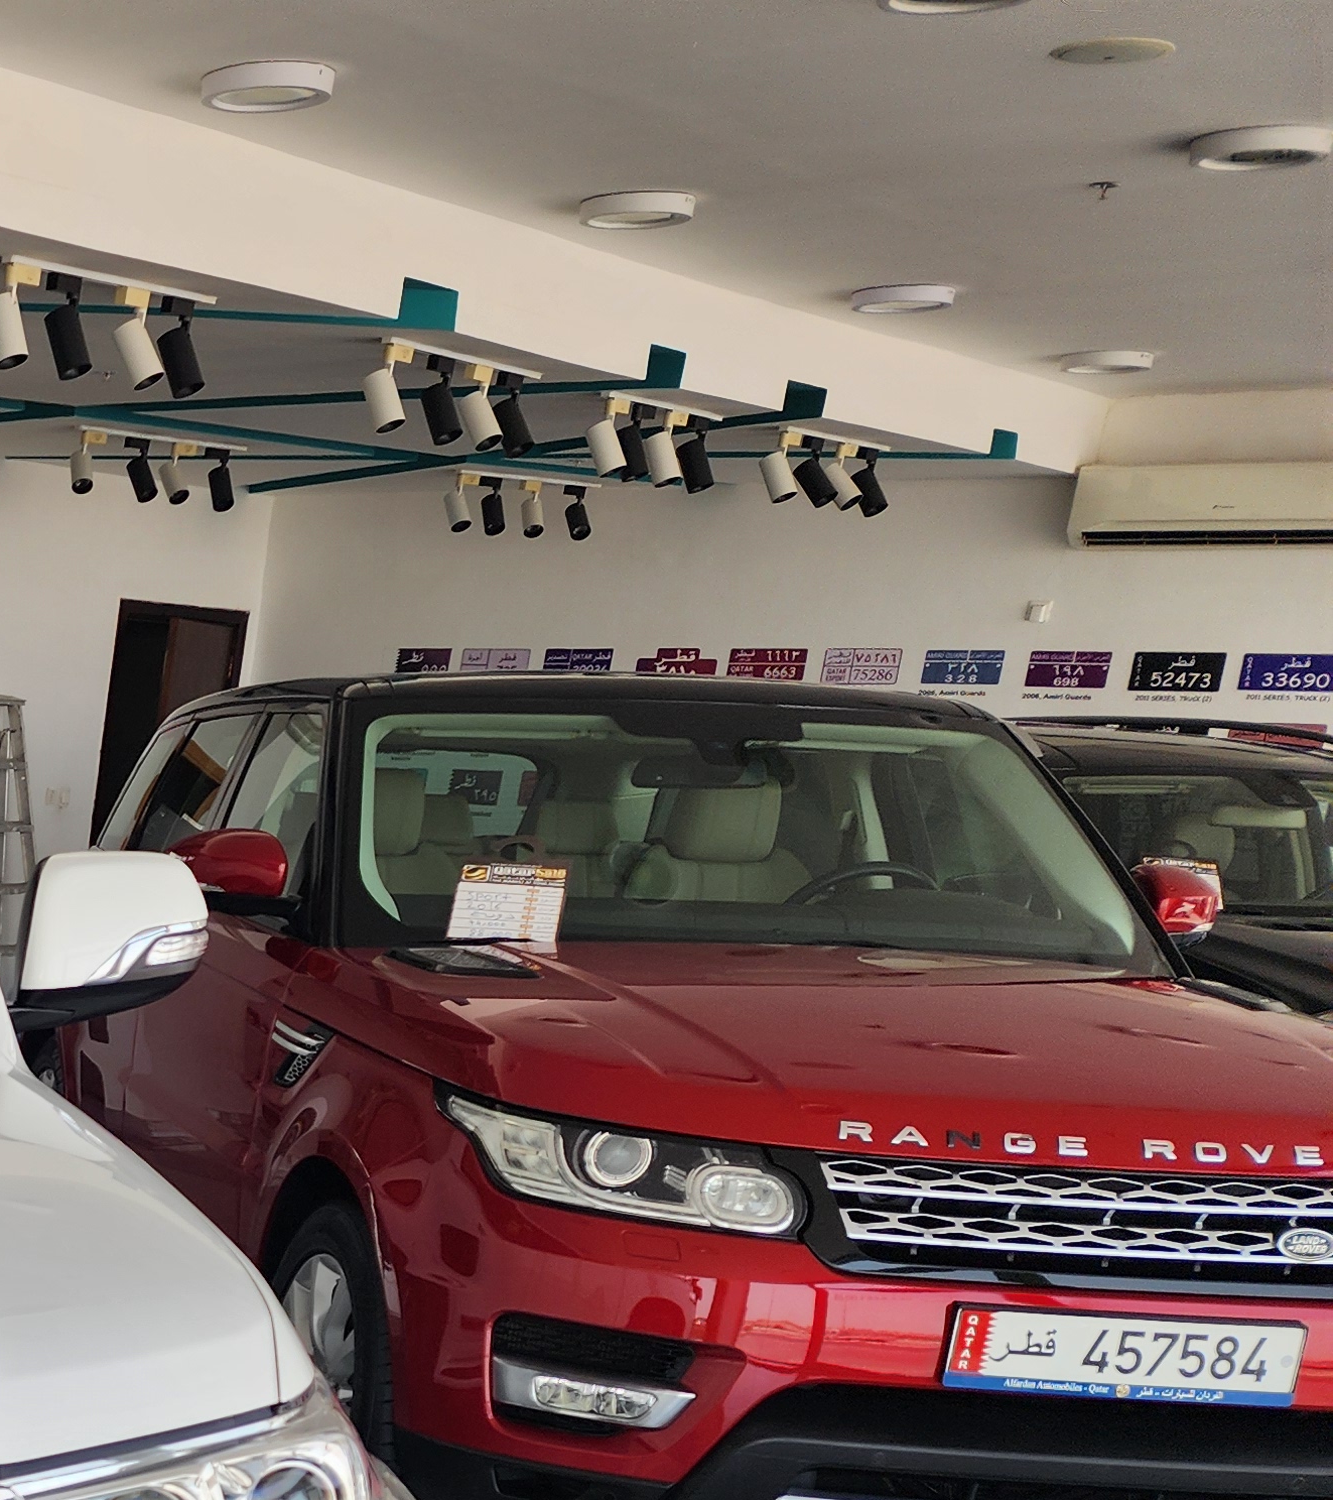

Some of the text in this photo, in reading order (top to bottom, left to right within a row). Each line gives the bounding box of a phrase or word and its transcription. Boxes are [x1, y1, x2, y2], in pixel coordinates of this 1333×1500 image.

[654, 649, 696, 665] قطر
[1168, 655, 1196, 670] قطر
[1280, 656, 1312, 671] قطر
[730, 665, 754, 673] QATAR
[764, 665, 797, 679] 6663
[853, 668, 893, 681] 75286
[944, 674, 978, 683] 328
[1053, 676, 1079, 687] 698
[1149, 671, 1212, 688] 52473
[1261, 671, 1331, 689] 33690
[838, 1119, 1089, 1158] RANGE
[1292, 1235, 1320, 1245] LAND
[1293, 1244, 1329, 1255] ROVER
[957, 1314, 979, 1370] QATAR
[988, 1328, 1058, 1362] قطر
[1082, 1328, 1269, 1383] 457584
[1088, 1383, 1110, 1394] Qatar
[1135, 1386, 1154, 1398] قطر
